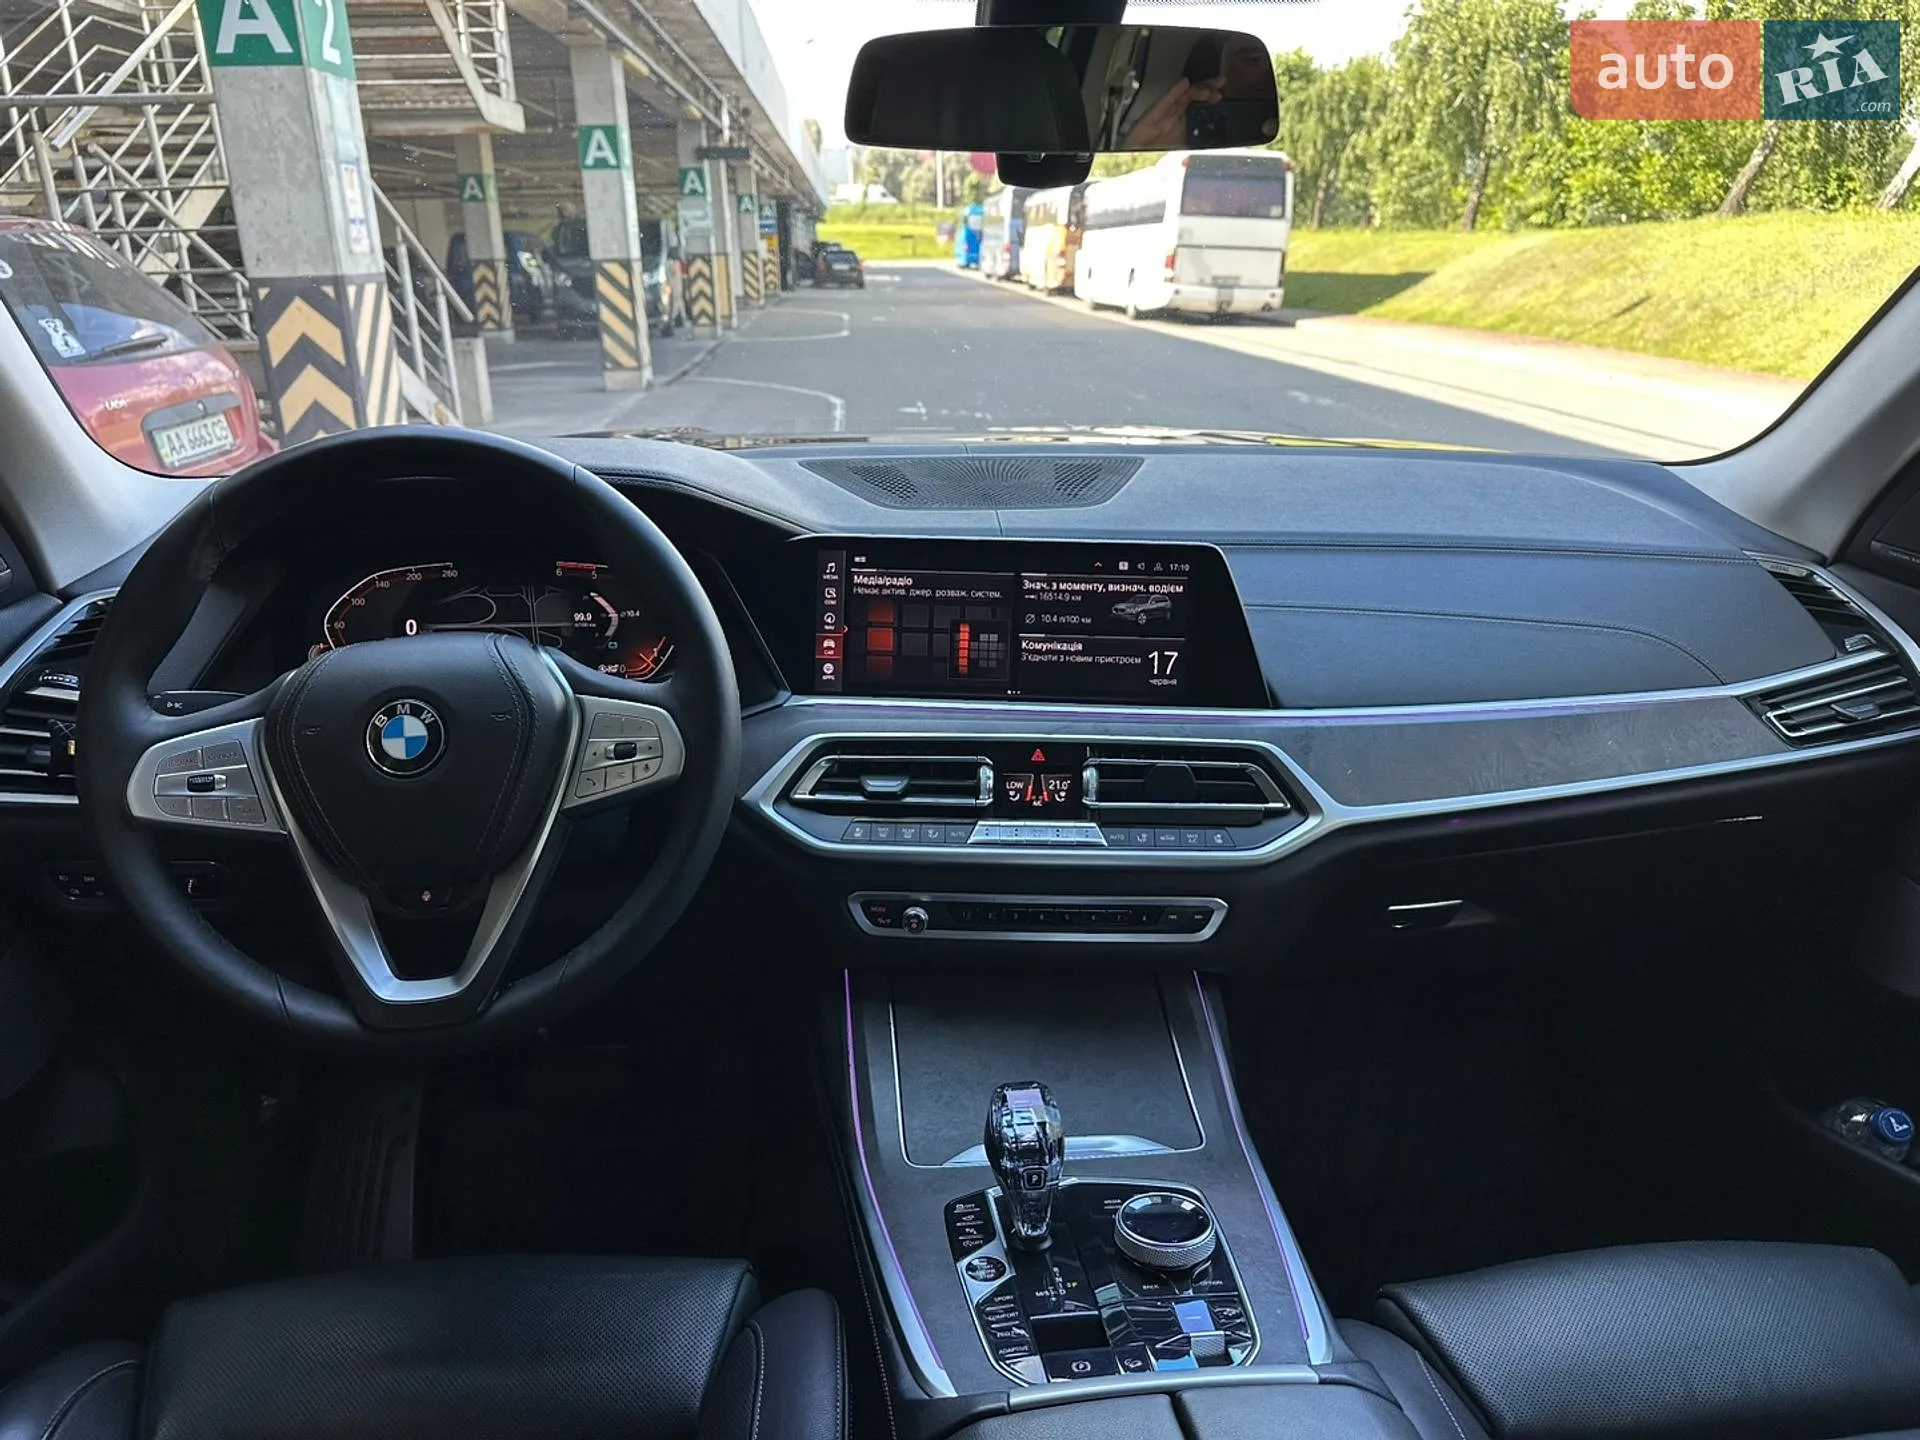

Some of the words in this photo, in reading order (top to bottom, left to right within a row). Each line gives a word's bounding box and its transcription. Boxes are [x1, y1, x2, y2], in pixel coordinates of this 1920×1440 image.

[216, 0, 294, 53] A
[314, 0, 342, 65] 2
[584, 129, 617, 166] A
[463, 179, 483, 201] A
[682, 171, 704, 195] A
[739, 195, 755, 213] A
[165, 432, 187, 454] AA
[406, 572, 423, 581] 200
[441, 569, 458, 578] 260
[556, 568, 563, 577] 6
[591, 571, 598, 580] 5
[375, 580, 390, 589] 140
[853, 574, 913, 588] Медіа/радіо
[1022, 580, 1050, 590] Знач.
[1059, 583, 1107, 593] моменту,
[1107, 585, 1147, 593] визнач.
[1149, 585, 1184, 594] водієм
[351, 598, 366, 607] 100
[573, 612, 592, 622] 99.9
[1041, 614, 1058, 623] 10.4
[405, 618, 418, 636] 0
[1021, 640, 1083, 652] Комунікація
[1148, 650, 1179, 675] 17
[374, 703, 436, 728] BMW
[1006, 781, 1024, 789] LOW
[1031, 1174, 1039, 1184] P
